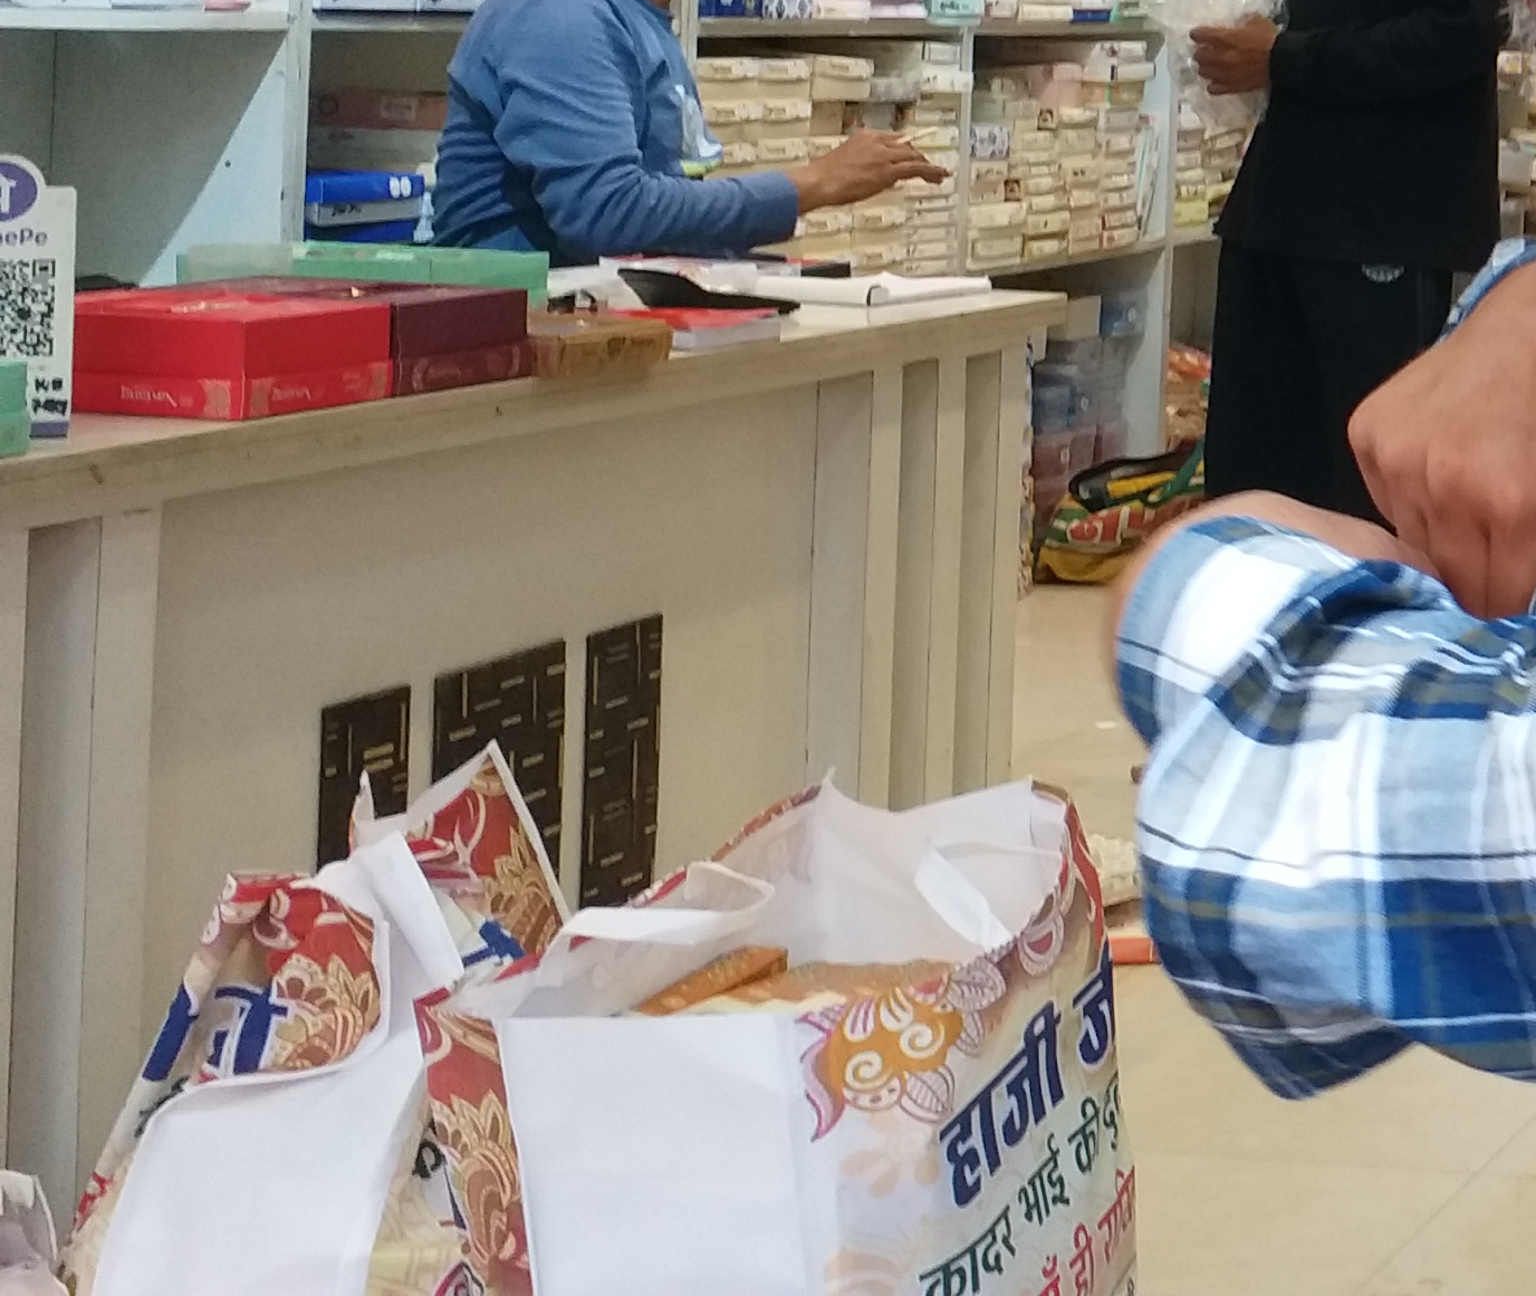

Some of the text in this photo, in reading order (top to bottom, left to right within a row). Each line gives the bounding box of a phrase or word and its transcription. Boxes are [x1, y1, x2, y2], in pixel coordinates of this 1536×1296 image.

[918, 1204, 1017, 1296] कादर
[1017, 1133, 1071, 1227] भाई
[1067, 1095, 1101, 1174] की
[939, 1000, 1066, 1208] हाजी
